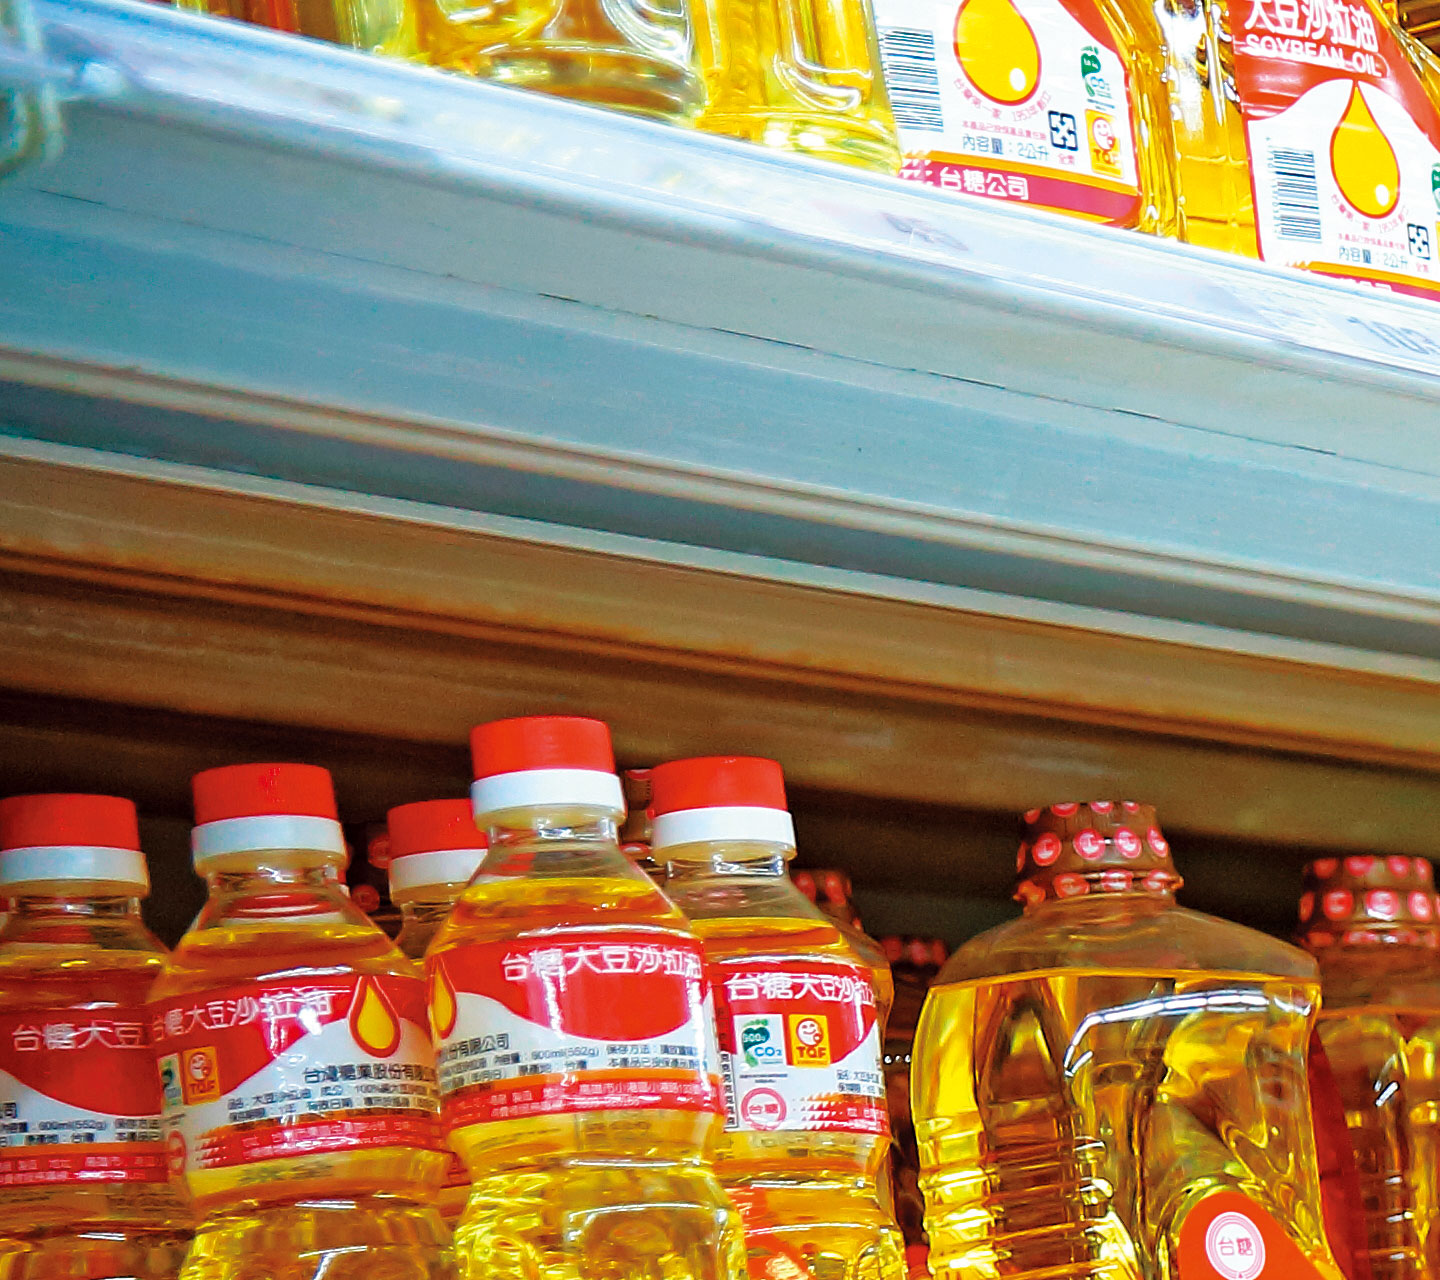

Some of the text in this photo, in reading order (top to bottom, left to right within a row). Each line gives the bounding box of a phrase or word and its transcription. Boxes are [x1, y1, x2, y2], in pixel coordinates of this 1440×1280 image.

[1244, 0, 1379, 52] 大豆沙拉油
[940, 168, 1029, 200] 台糖公司
[796, 1046, 827, 1058] TQF
[189, 1081, 216, 1094] TQF
[749, 1104, 778, 1115] 台糖
[1218, 1236, 1253, 1257] 台糖
